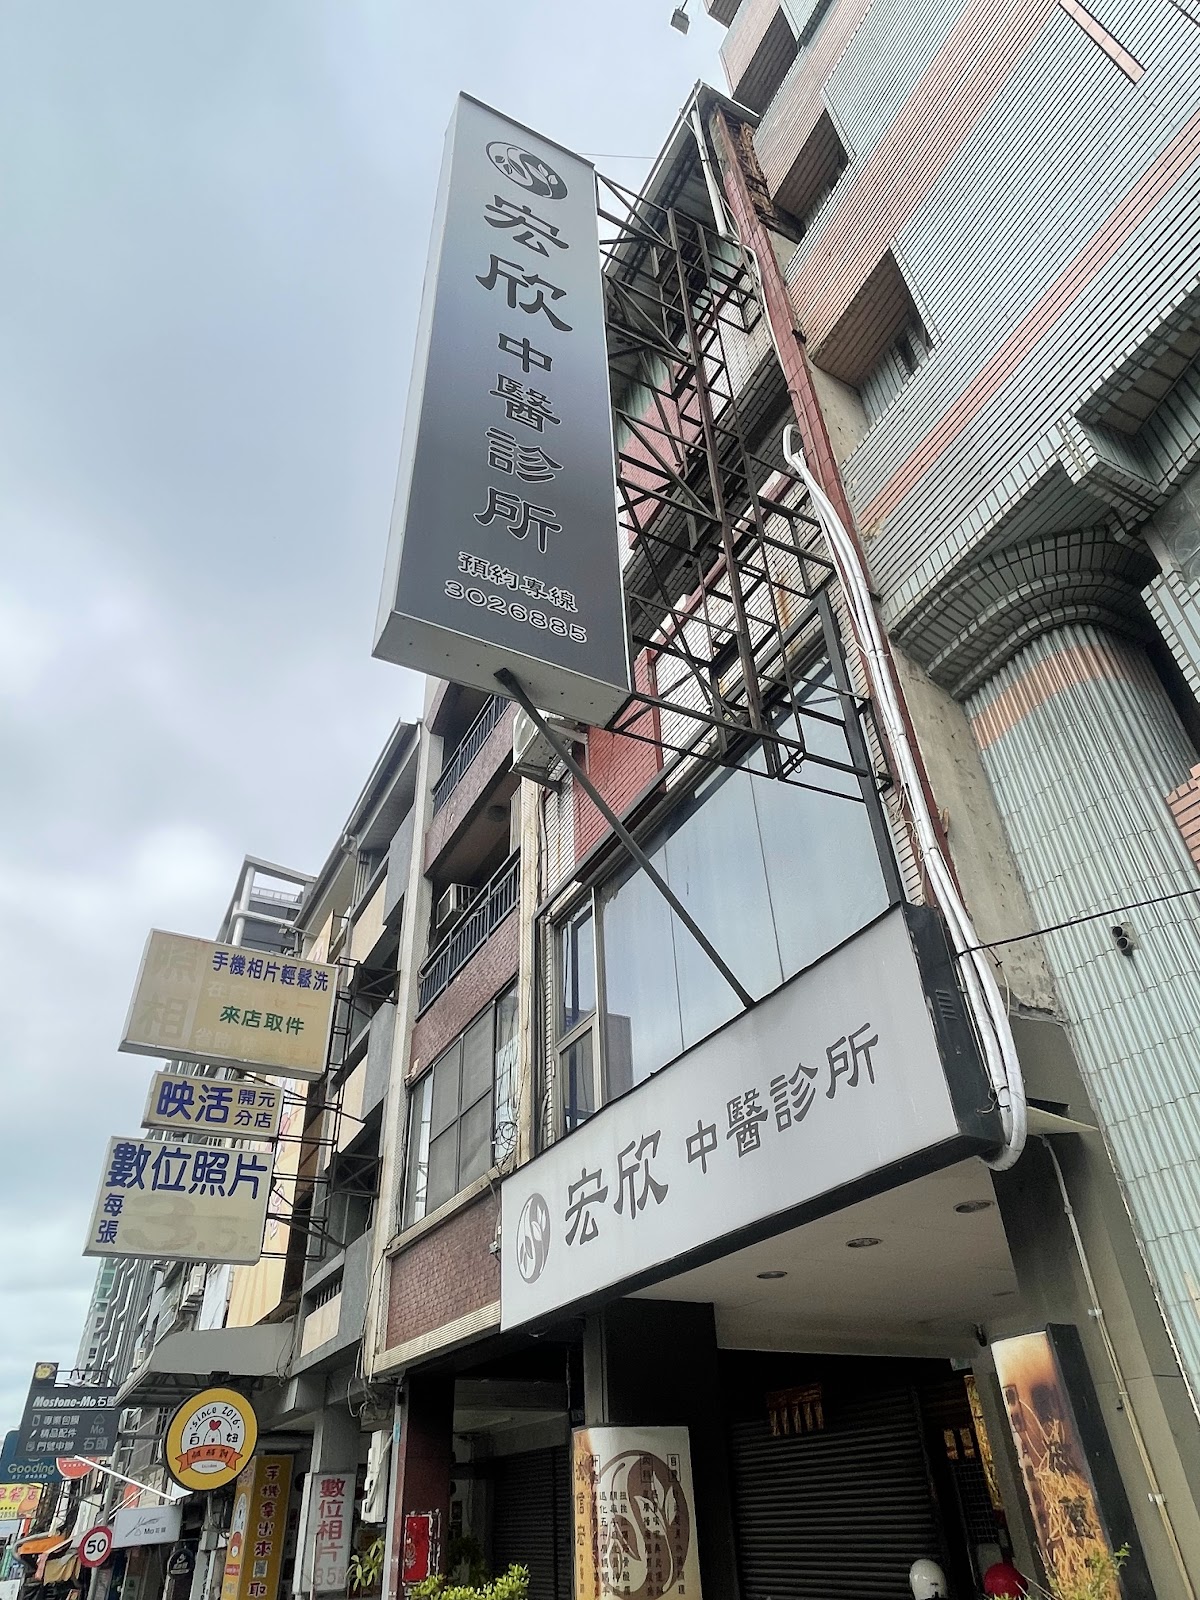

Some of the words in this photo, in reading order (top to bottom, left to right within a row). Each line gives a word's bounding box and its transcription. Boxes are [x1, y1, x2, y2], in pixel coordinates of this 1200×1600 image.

[457, 551, 578, 613] 預約專線
[444, 580, 587, 643] 3026885
[212, 950, 329, 992] 手機相片輕鬆洗
[219, 1005, 305, 1036] 來店取件
[156, 1080, 234, 1123] 映活
[234, 1110, 273, 1129] 分店
[238, 1089, 276, 1108] 開元
[105, 1142, 268, 1199] 數位照片
[96, 1192, 125, 1244] 每張
[90, 1425, 105, 1435] Mo
[7, 1462, 55, 1475] Gooding
[316, 1477, 346, 1563] 數位相片
[86, 1539, 107, 1555] 50
